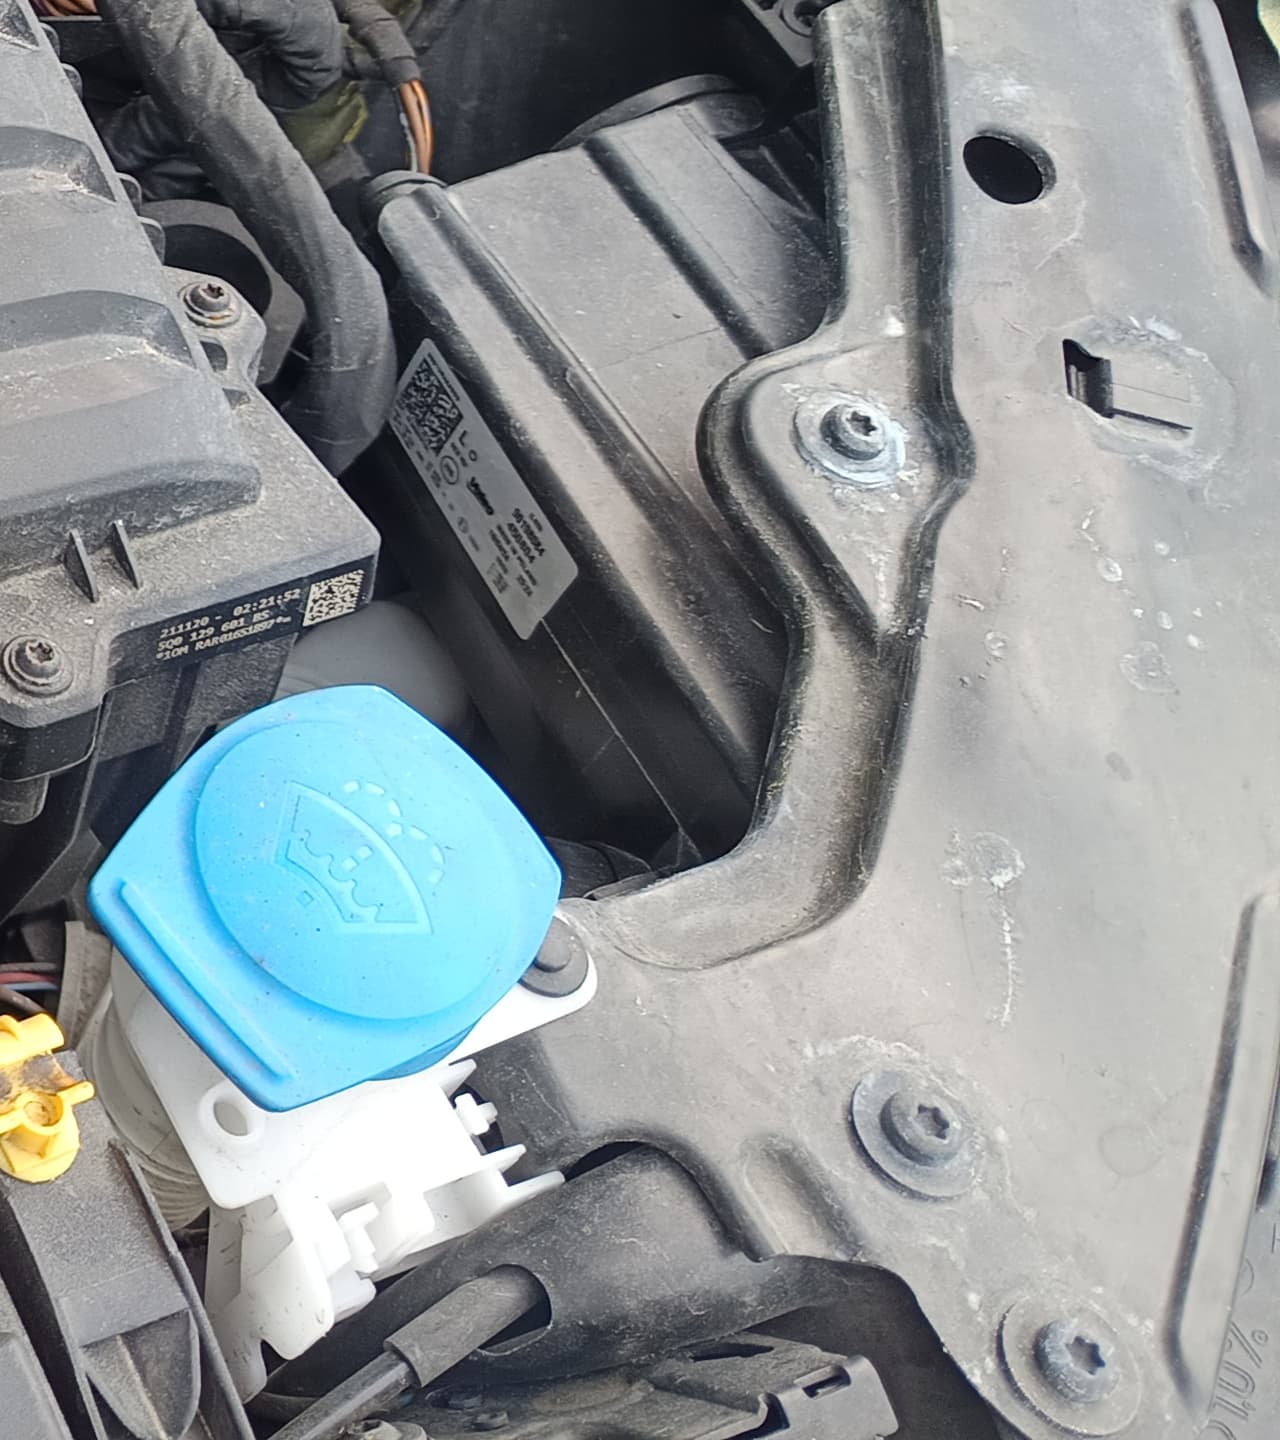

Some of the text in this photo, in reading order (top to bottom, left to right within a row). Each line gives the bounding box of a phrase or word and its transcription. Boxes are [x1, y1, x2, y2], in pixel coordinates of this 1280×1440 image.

[160, 616, 210, 639] 211120
[233, 588, 302, 617] 02:21:52
[190, 626, 215, 642] 129
[220, 618, 245, 633] 601
